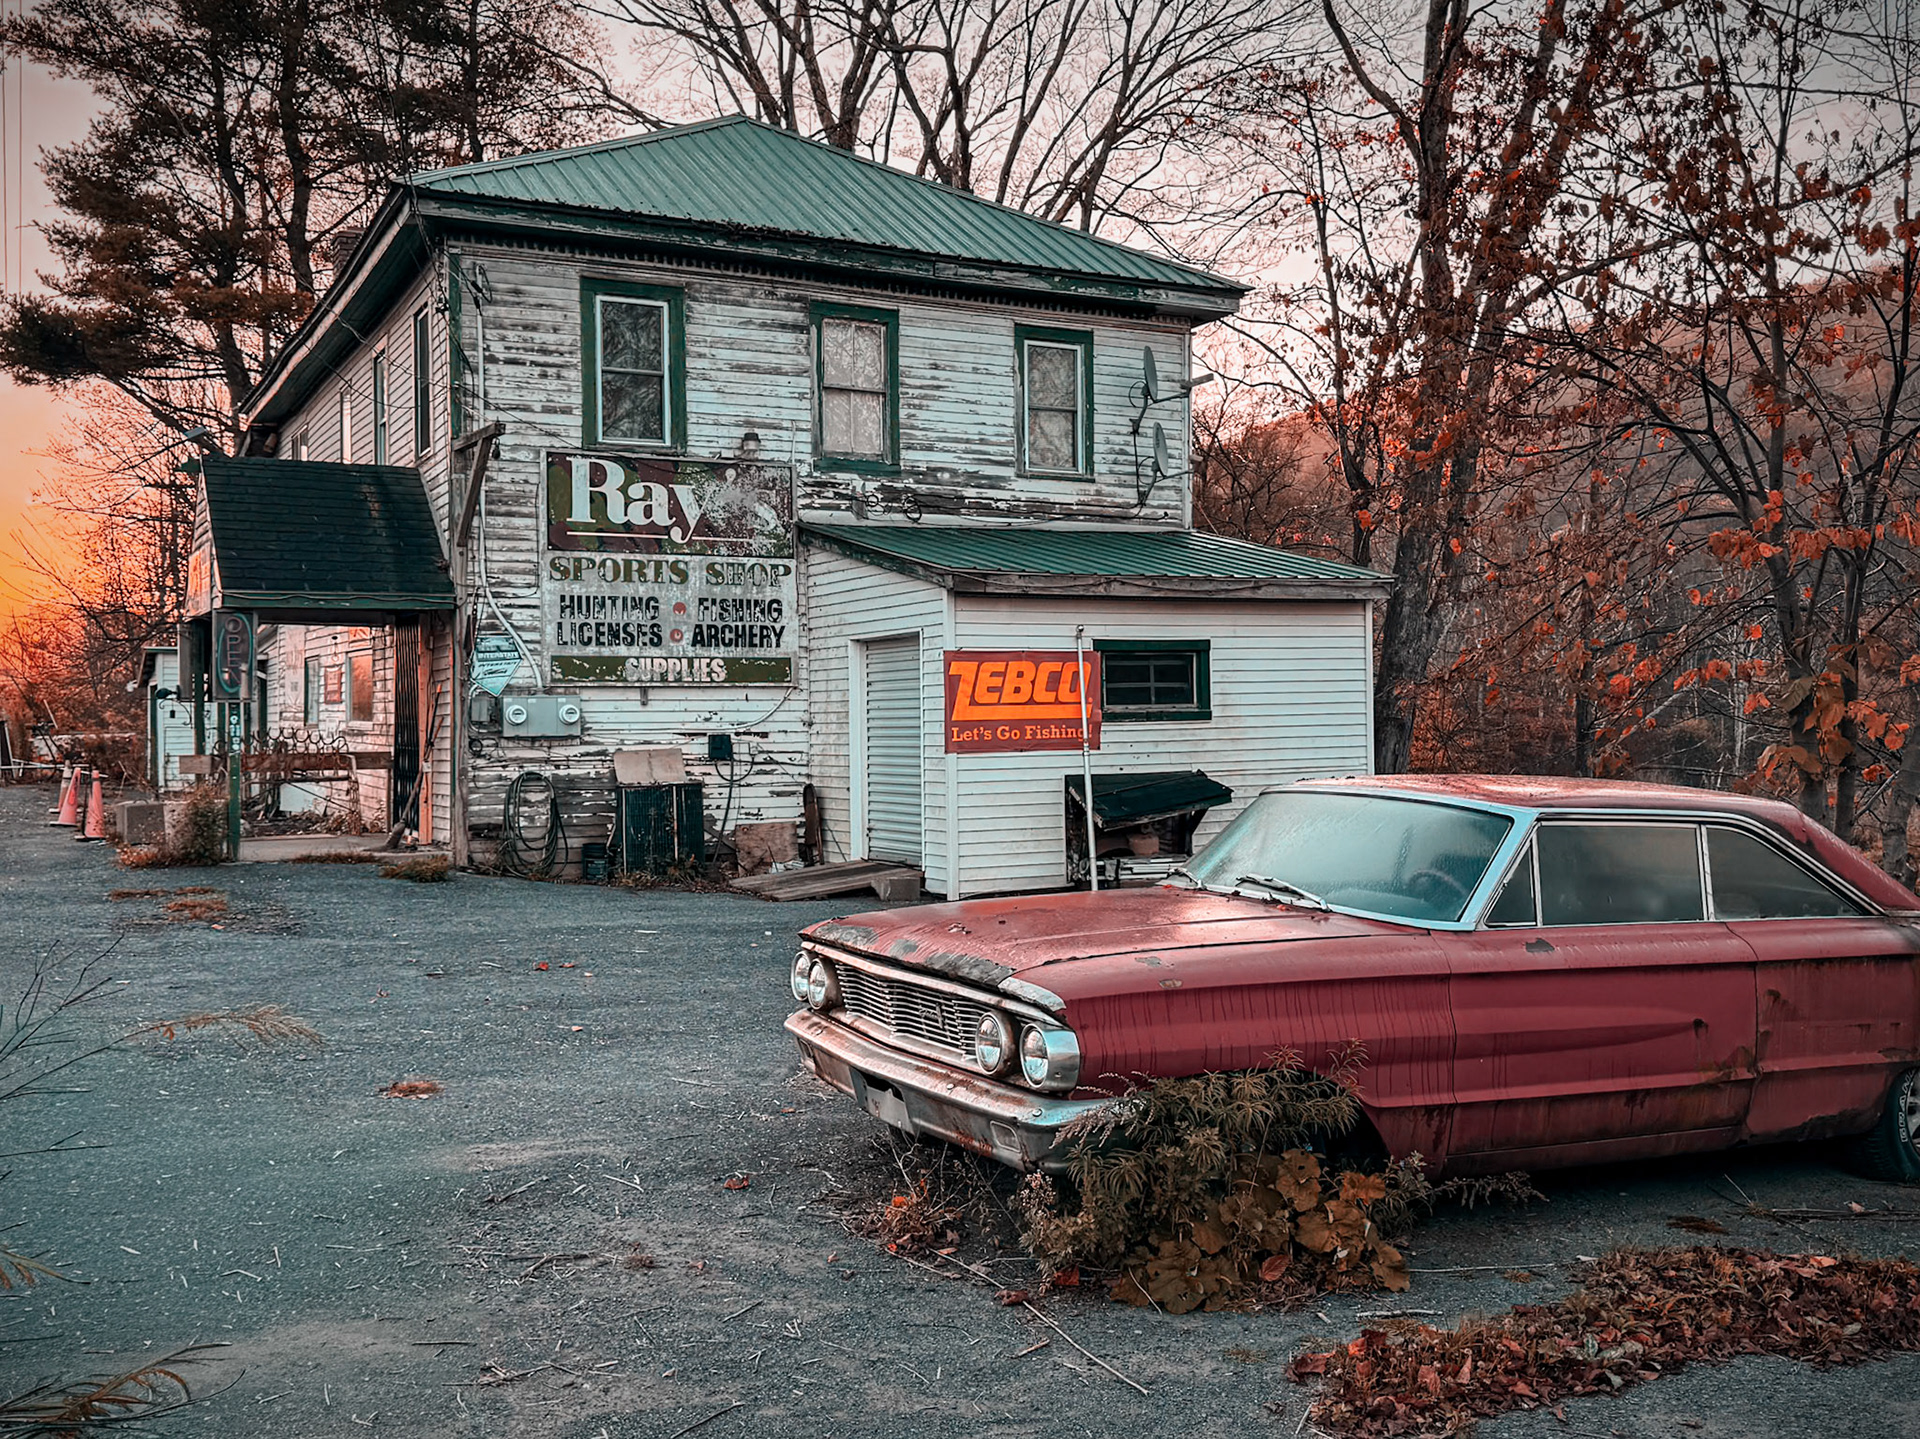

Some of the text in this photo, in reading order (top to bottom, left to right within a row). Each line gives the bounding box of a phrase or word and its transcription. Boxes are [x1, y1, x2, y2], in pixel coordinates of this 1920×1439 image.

[549, 556, 792, 588] SPORTS SHOP
[559, 594, 783, 623] HUNTING FISHING
[557, 621, 786, 648] LICENSES ARCHERY
[624, 656, 727, 682] SUPPLIES
[949, 660, 1093, 721] ZEBCO
[951, 726, 992, 742] Let's
[996, 726, 1021, 741] Go
